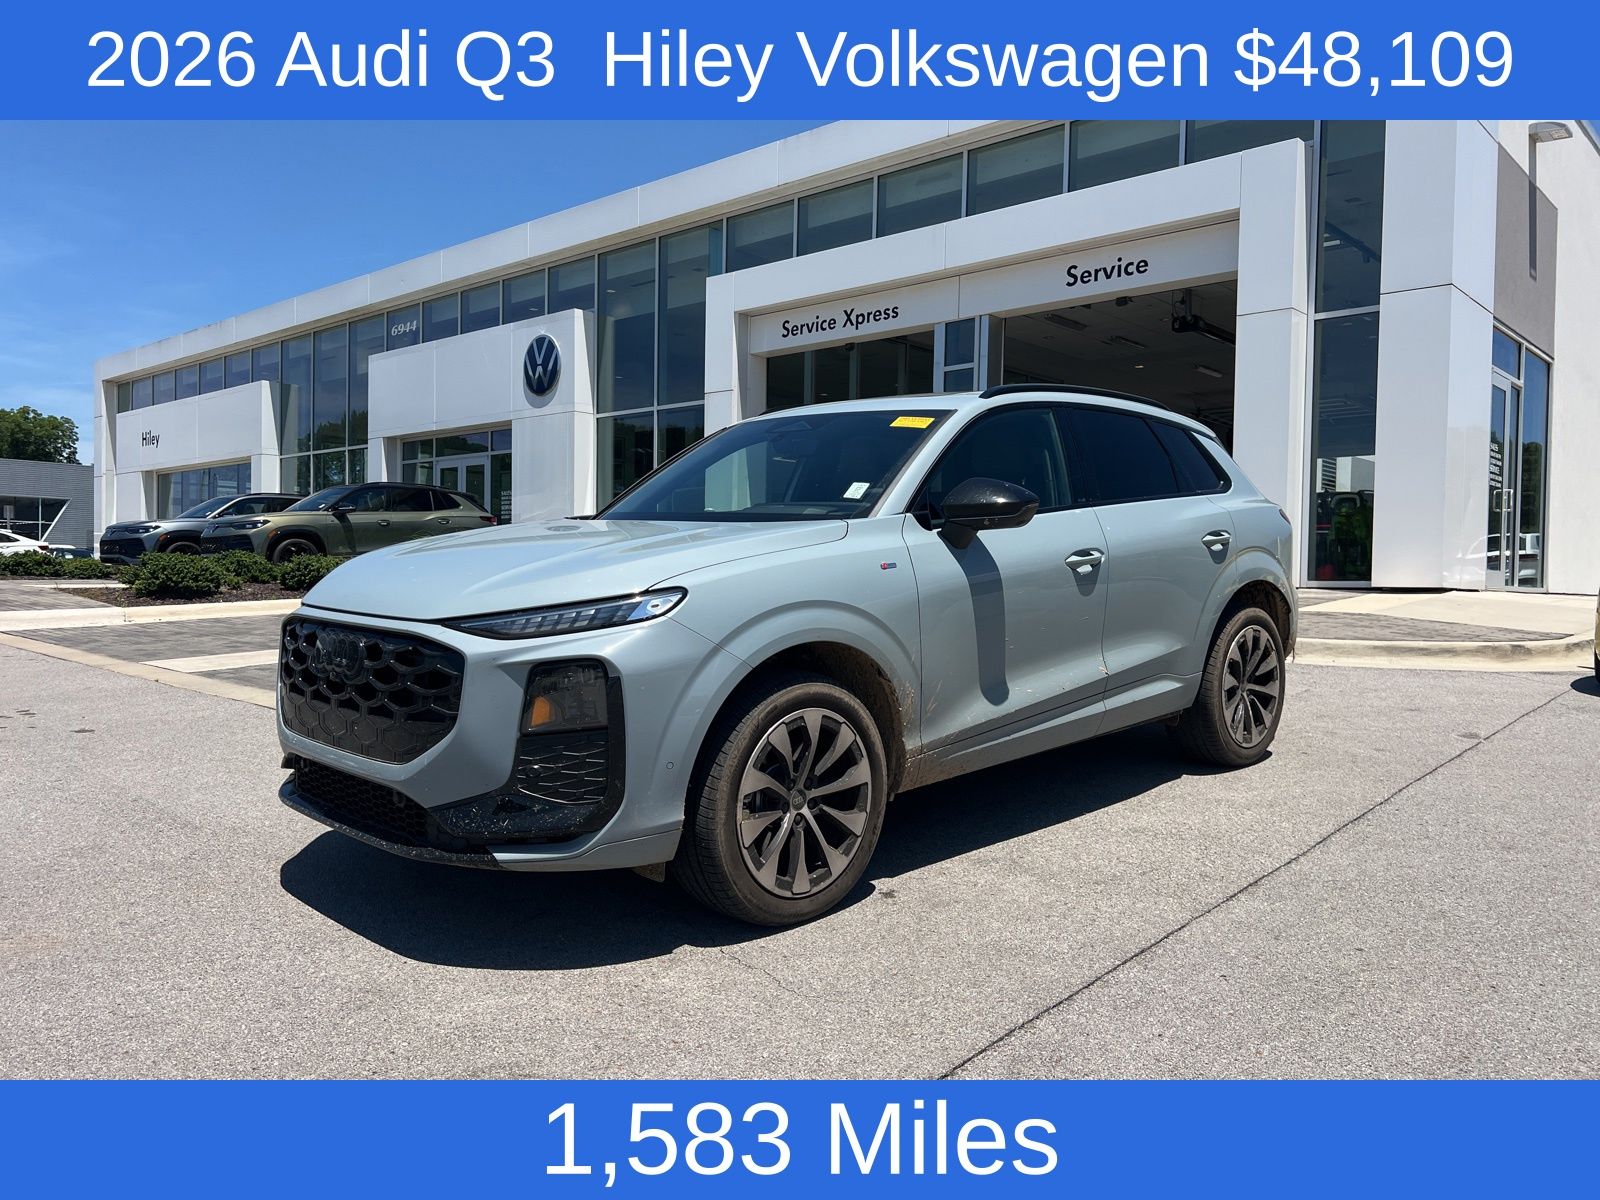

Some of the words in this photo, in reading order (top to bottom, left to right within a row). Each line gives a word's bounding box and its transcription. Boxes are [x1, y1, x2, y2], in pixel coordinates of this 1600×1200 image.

[1065, 256, 1149, 287] Service
[391, 320, 417, 336] 6944
[781, 315, 837, 338] Service
[842, 306, 899, 330] Xpress
[141, 430, 160, 448] Hiley
